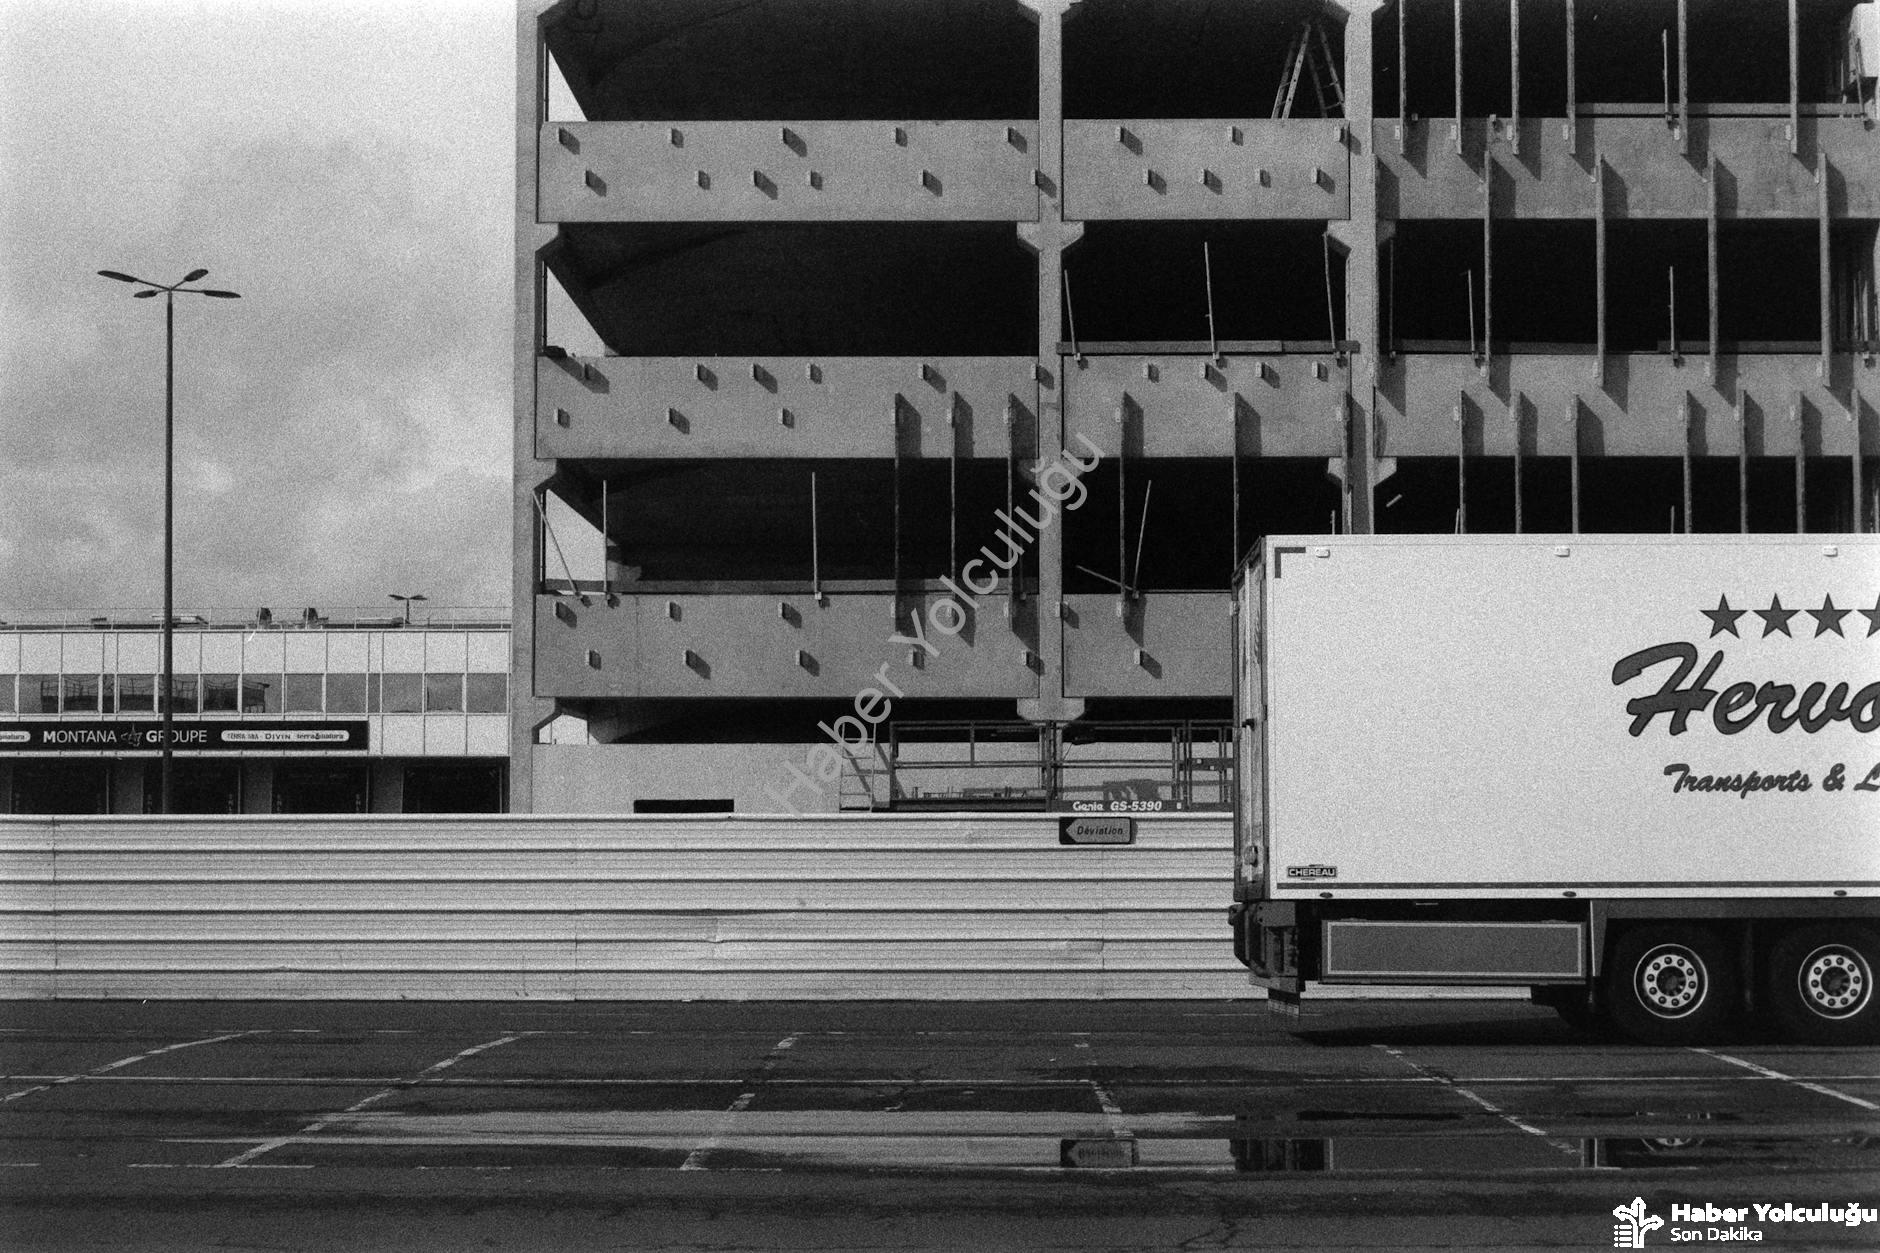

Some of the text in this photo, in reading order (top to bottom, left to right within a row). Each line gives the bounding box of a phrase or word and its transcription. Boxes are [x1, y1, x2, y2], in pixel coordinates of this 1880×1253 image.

[43, 730, 117, 743] MONTANA
[1663, 763, 1812, 799] Transports
[1822, 763, 1846, 791] &
[1072, 801, 1162, 811] Genie GS-5390
[1077, 825, 1123, 836] Déviation
[1288, 868, 1335, 876] CHEREAU
